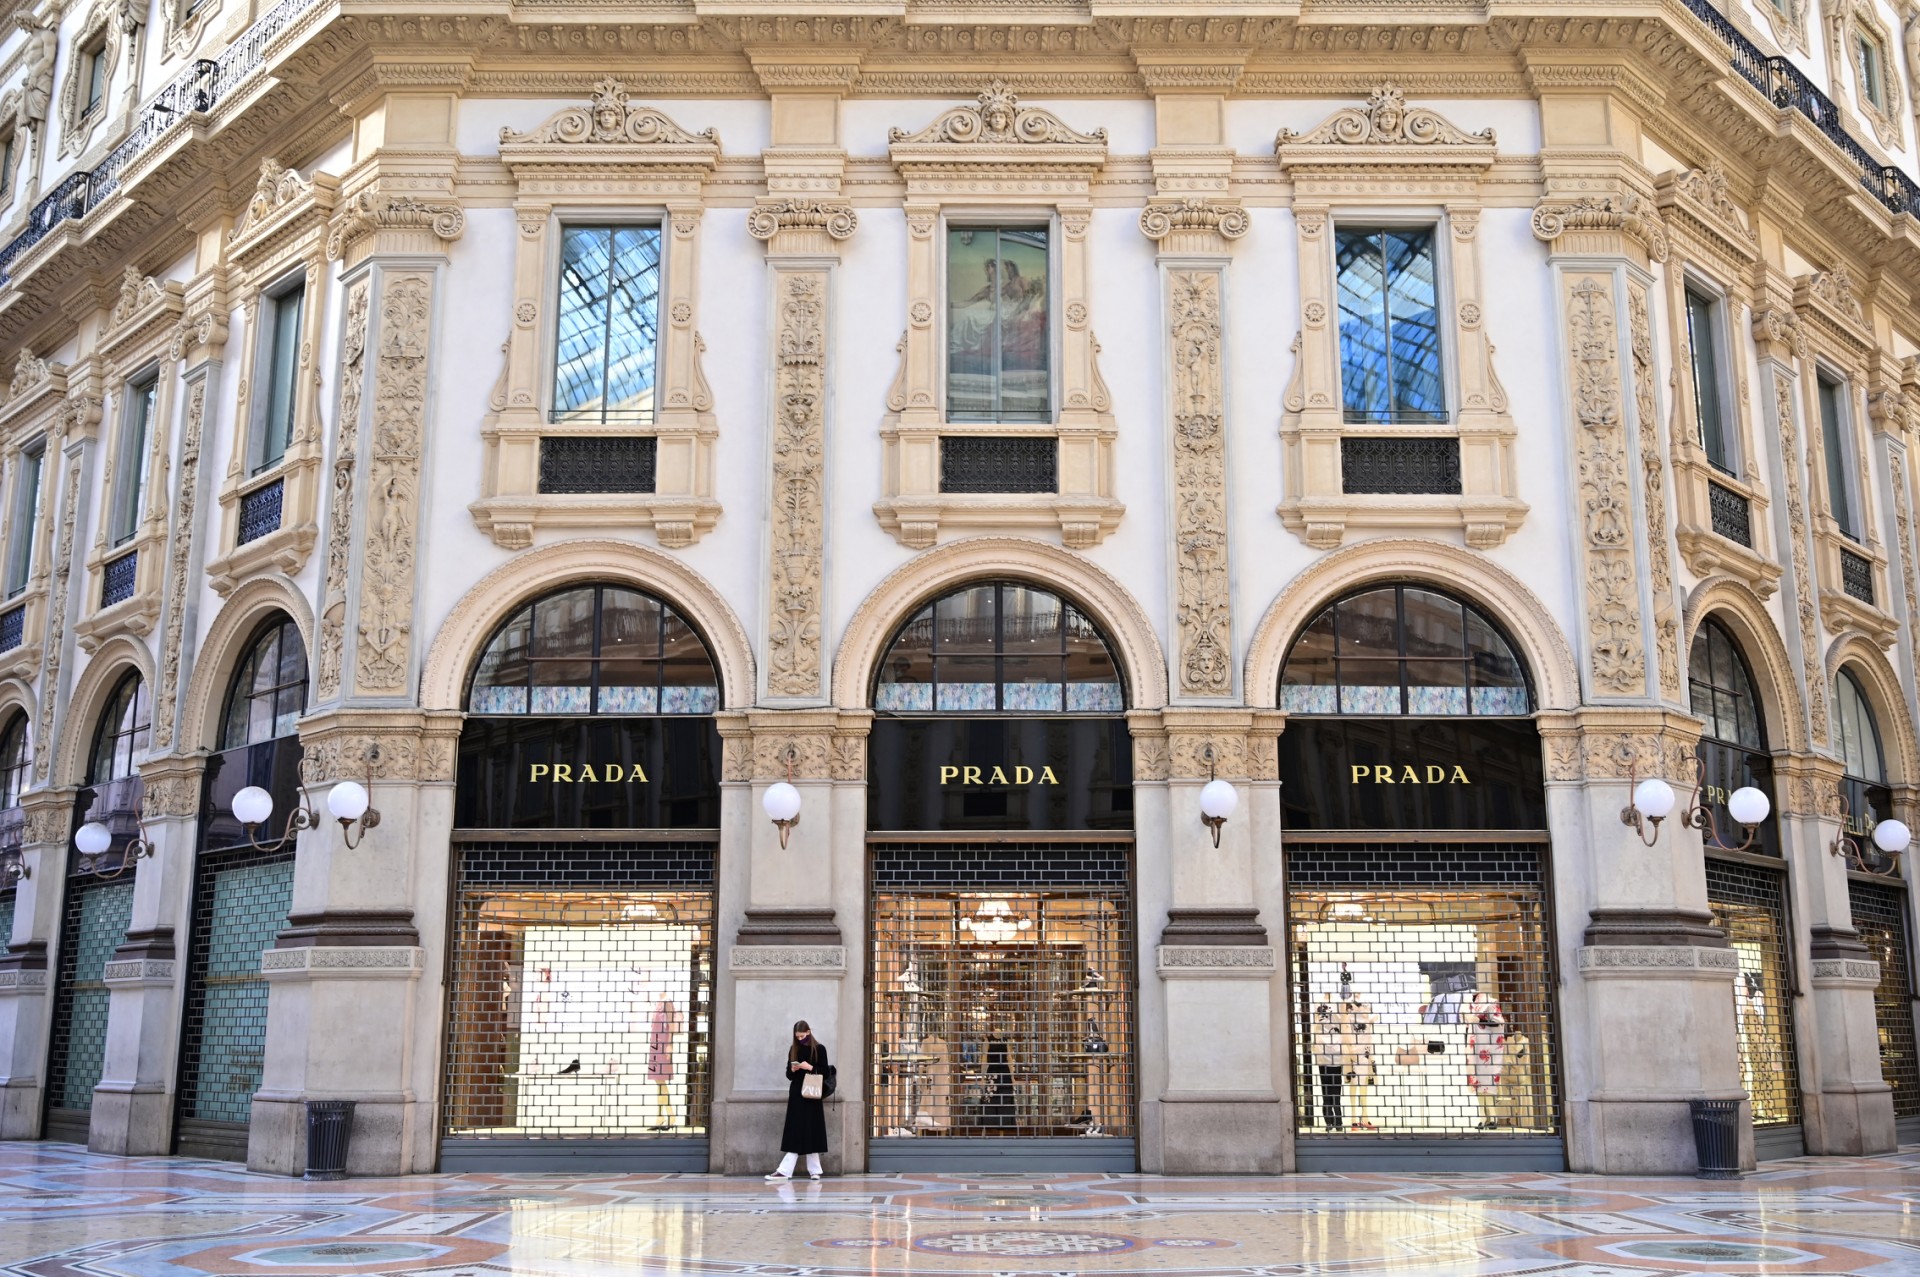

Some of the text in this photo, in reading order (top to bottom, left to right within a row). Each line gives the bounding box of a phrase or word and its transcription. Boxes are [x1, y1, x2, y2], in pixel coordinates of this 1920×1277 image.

[530, 763, 648, 782] PRADA
[940, 765, 1058, 784] PRADA
[1351, 765, 1470, 783] PRADA
